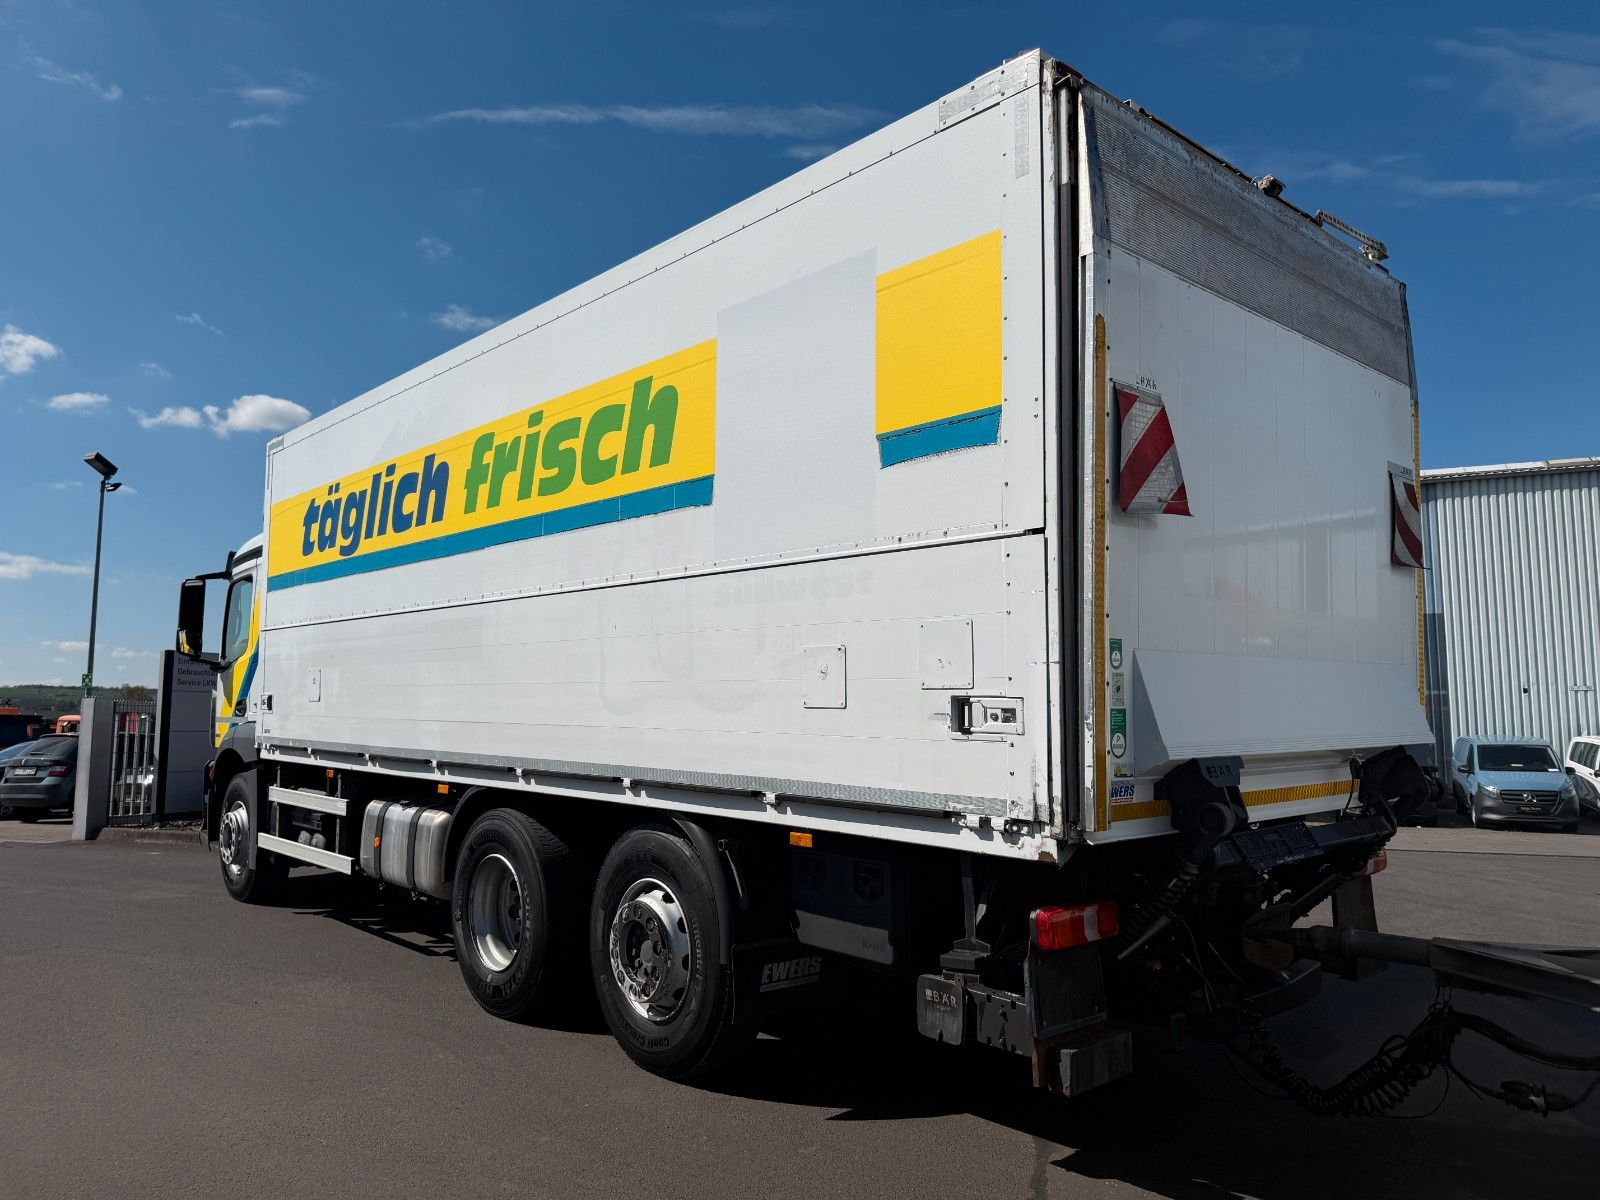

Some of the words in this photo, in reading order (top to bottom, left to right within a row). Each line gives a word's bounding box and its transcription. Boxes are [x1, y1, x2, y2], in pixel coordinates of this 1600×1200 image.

[302, 453, 450, 557] täglich
[463, 375, 679, 515] frisch
[177, 667, 218, 677] Gebrauchtw
[176, 678, 201, 687] Service
[1111, 784, 1135, 798] WERS
[761, 956, 822, 983] EWERS
[933, 990, 957, 1008] BÄR
